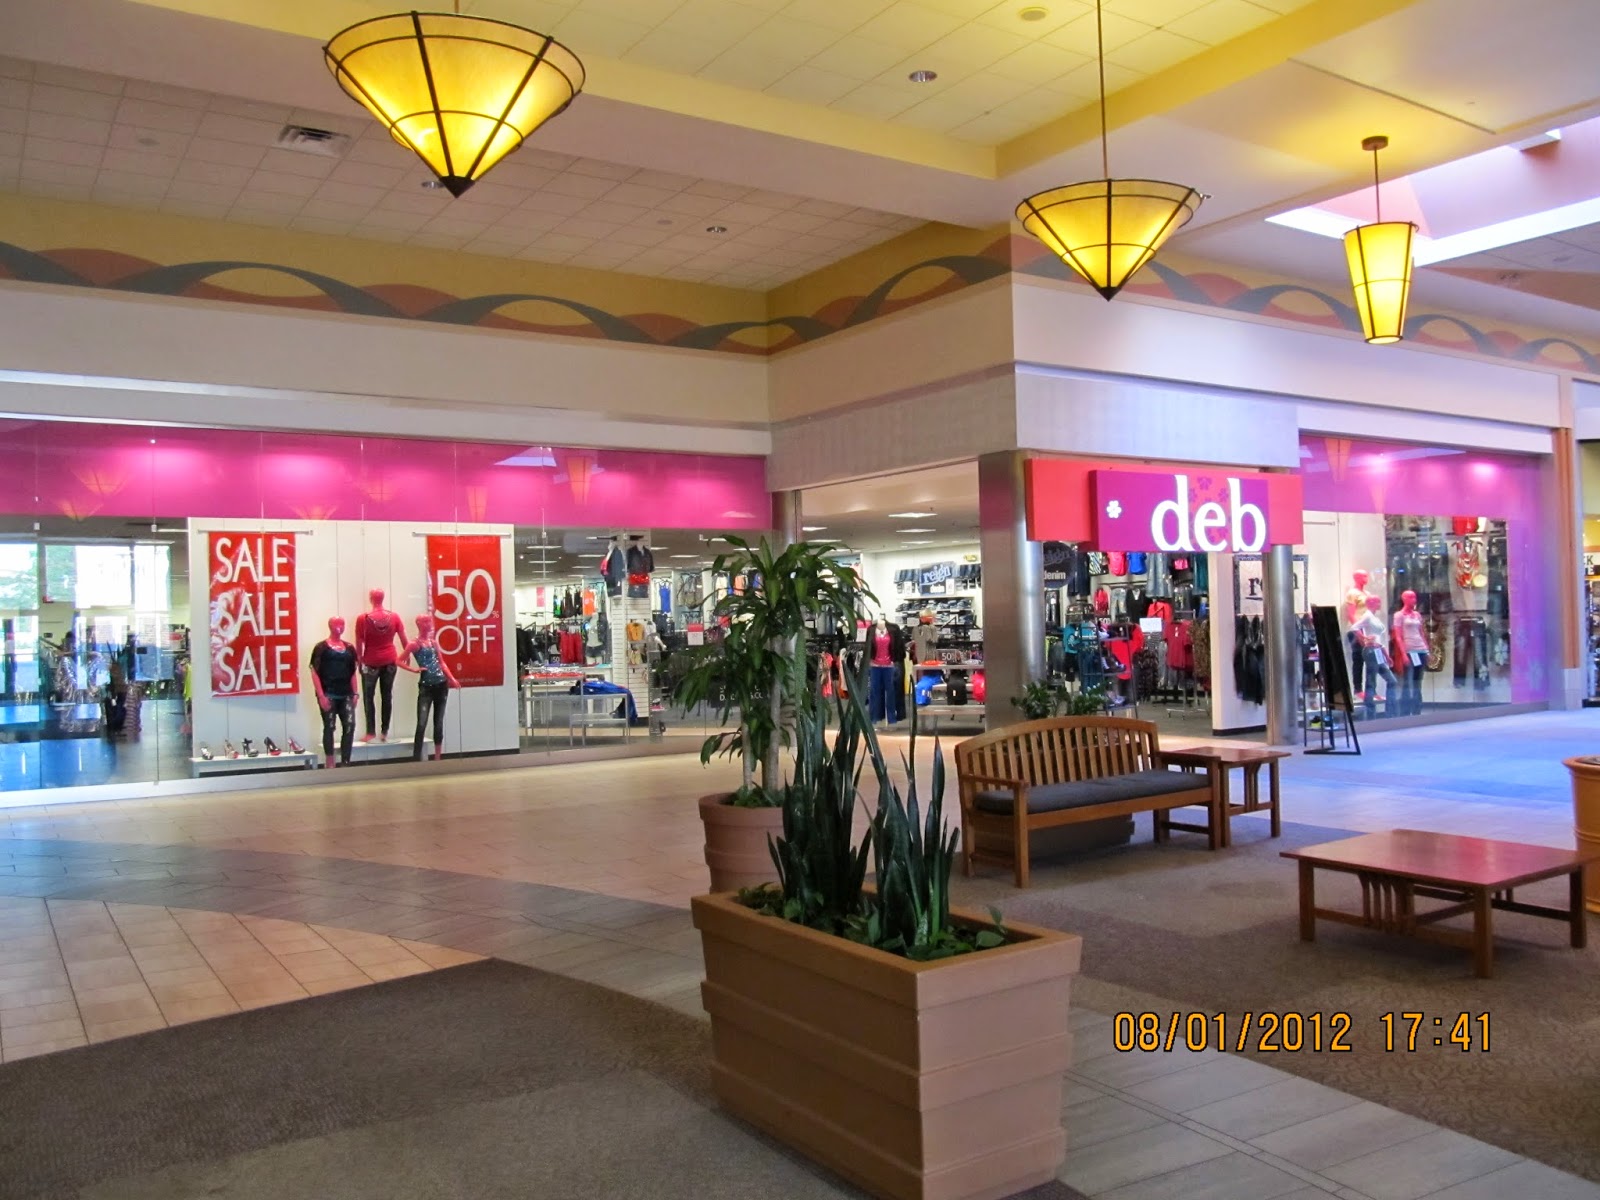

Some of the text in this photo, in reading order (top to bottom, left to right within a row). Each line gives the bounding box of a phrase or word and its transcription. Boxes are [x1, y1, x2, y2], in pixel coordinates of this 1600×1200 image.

[1151, 474, 1266, 552] deb
[215, 537, 289, 583] SALE
[217, 591, 292, 637] SALE
[435, 624, 497, 655] OFF
[215, 645, 293, 692] SALE
